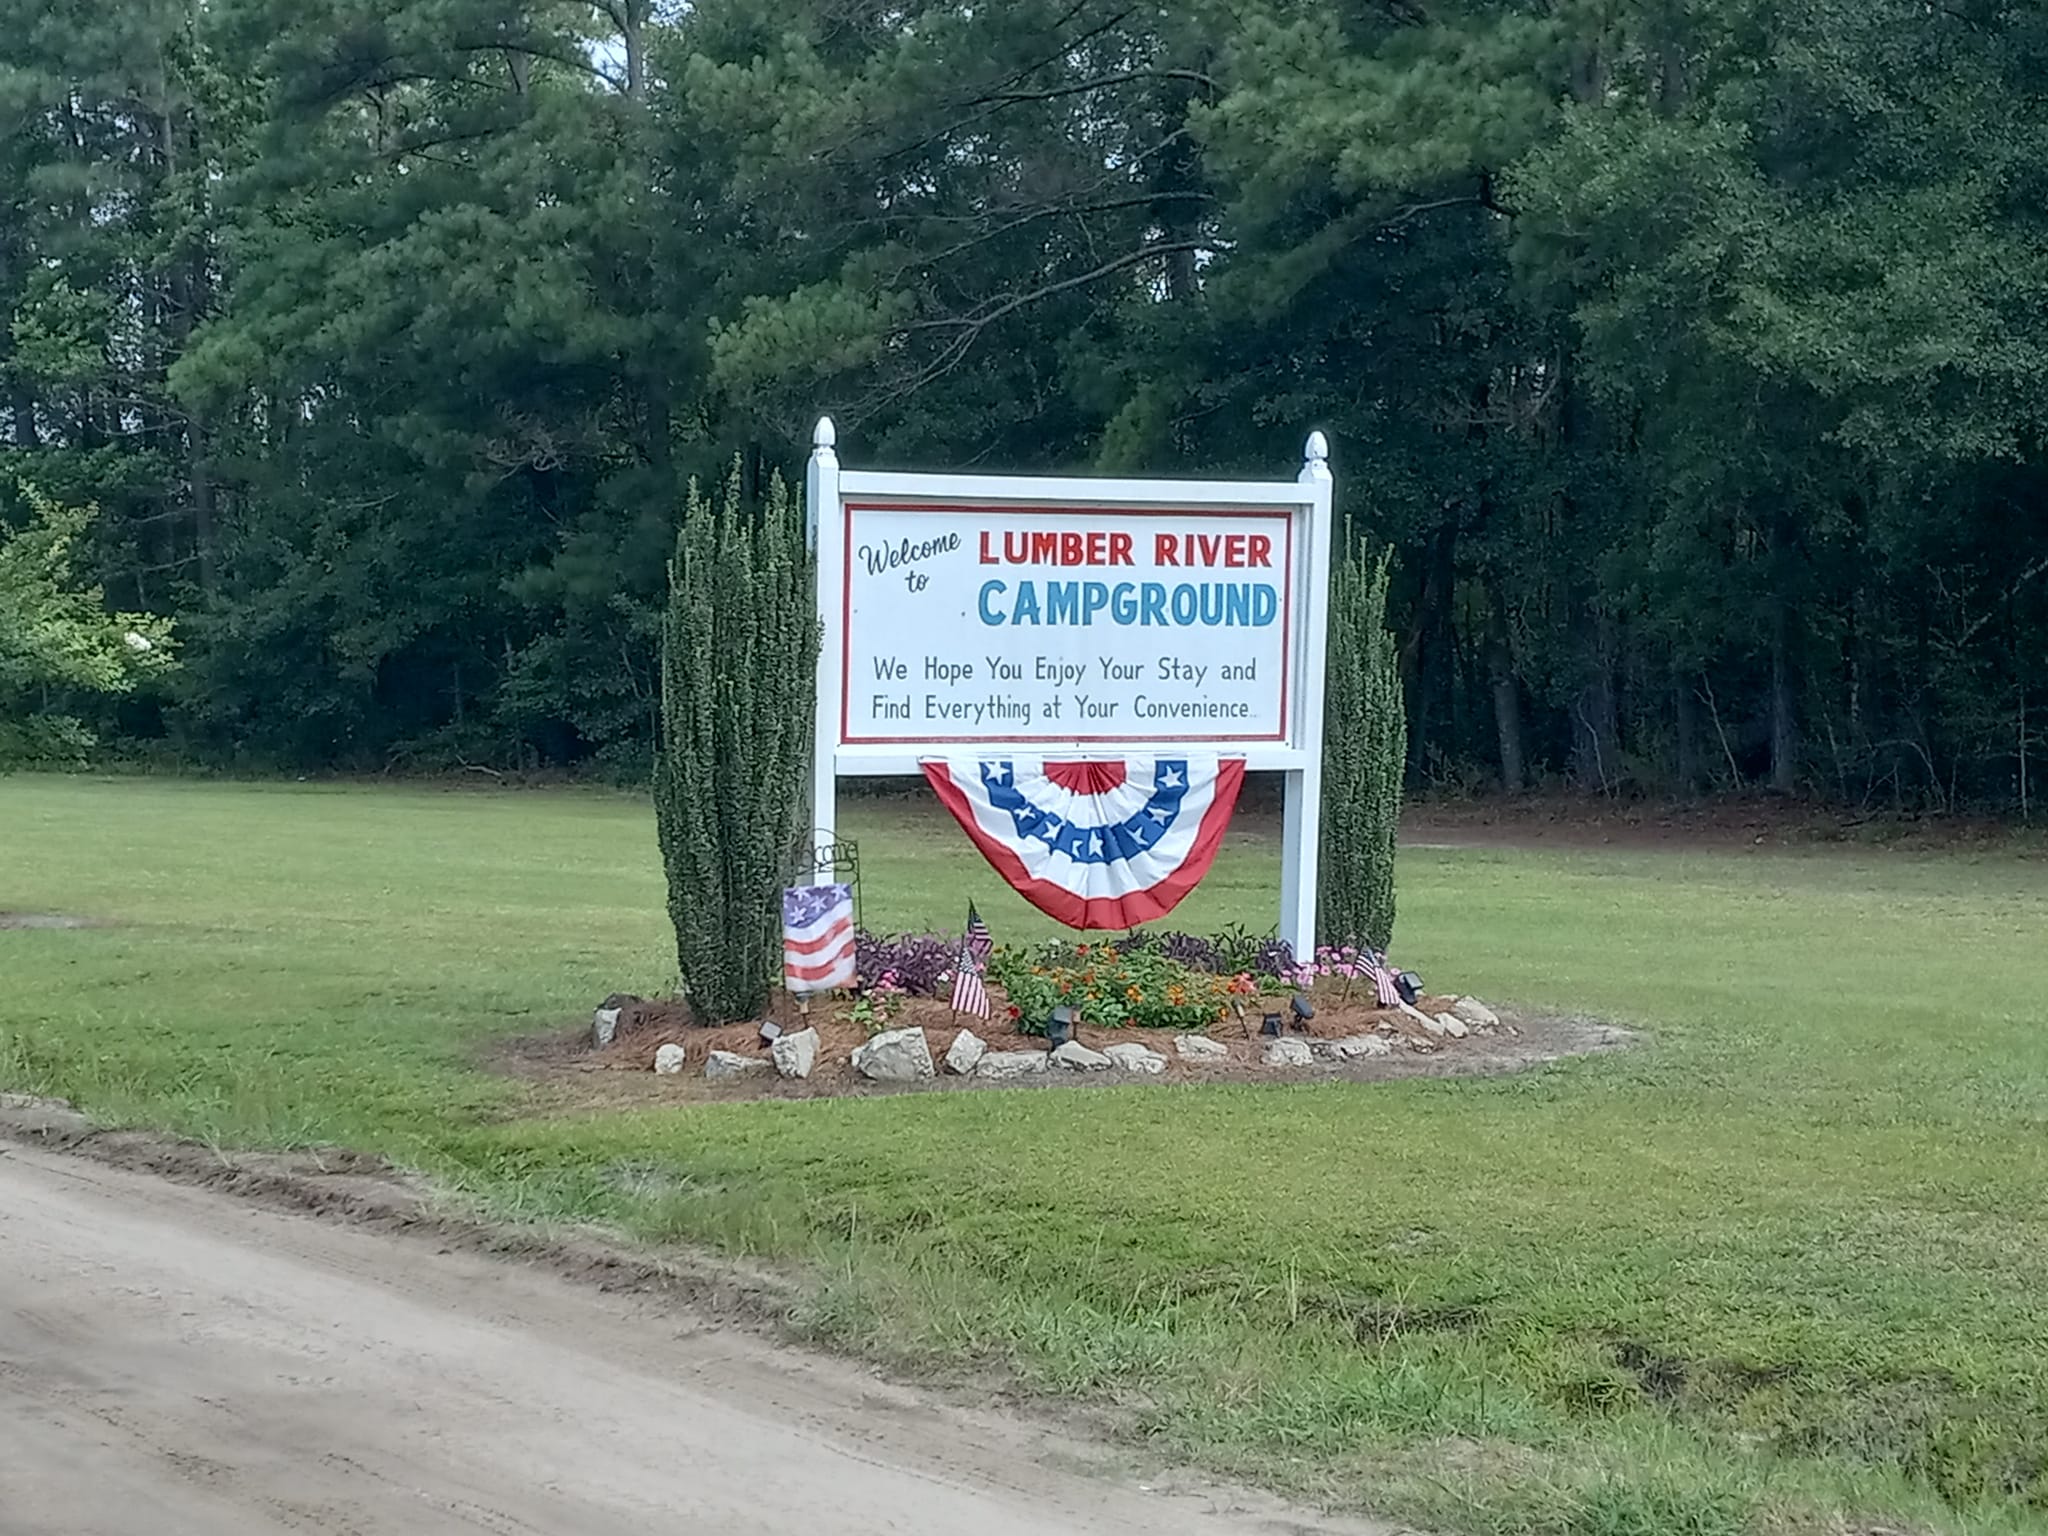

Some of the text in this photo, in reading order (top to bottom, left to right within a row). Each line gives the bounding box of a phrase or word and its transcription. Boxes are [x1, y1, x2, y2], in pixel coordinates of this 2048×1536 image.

[858, 532, 962, 576] Welcome
[979, 531, 1273, 568] LUMBER RIVER
[904, 570, 930, 593] to
[978, 579, 1277, 627] CAMPGROUND
[873, 656, 1257, 688] We Hope You Enjoy Your Stay and
[872, 694, 911, 719] Find
[925, 694, 1031, 725] Everything
[1042, 695, 1062, 719] at
[1074, 695, 1119, 718] Your
